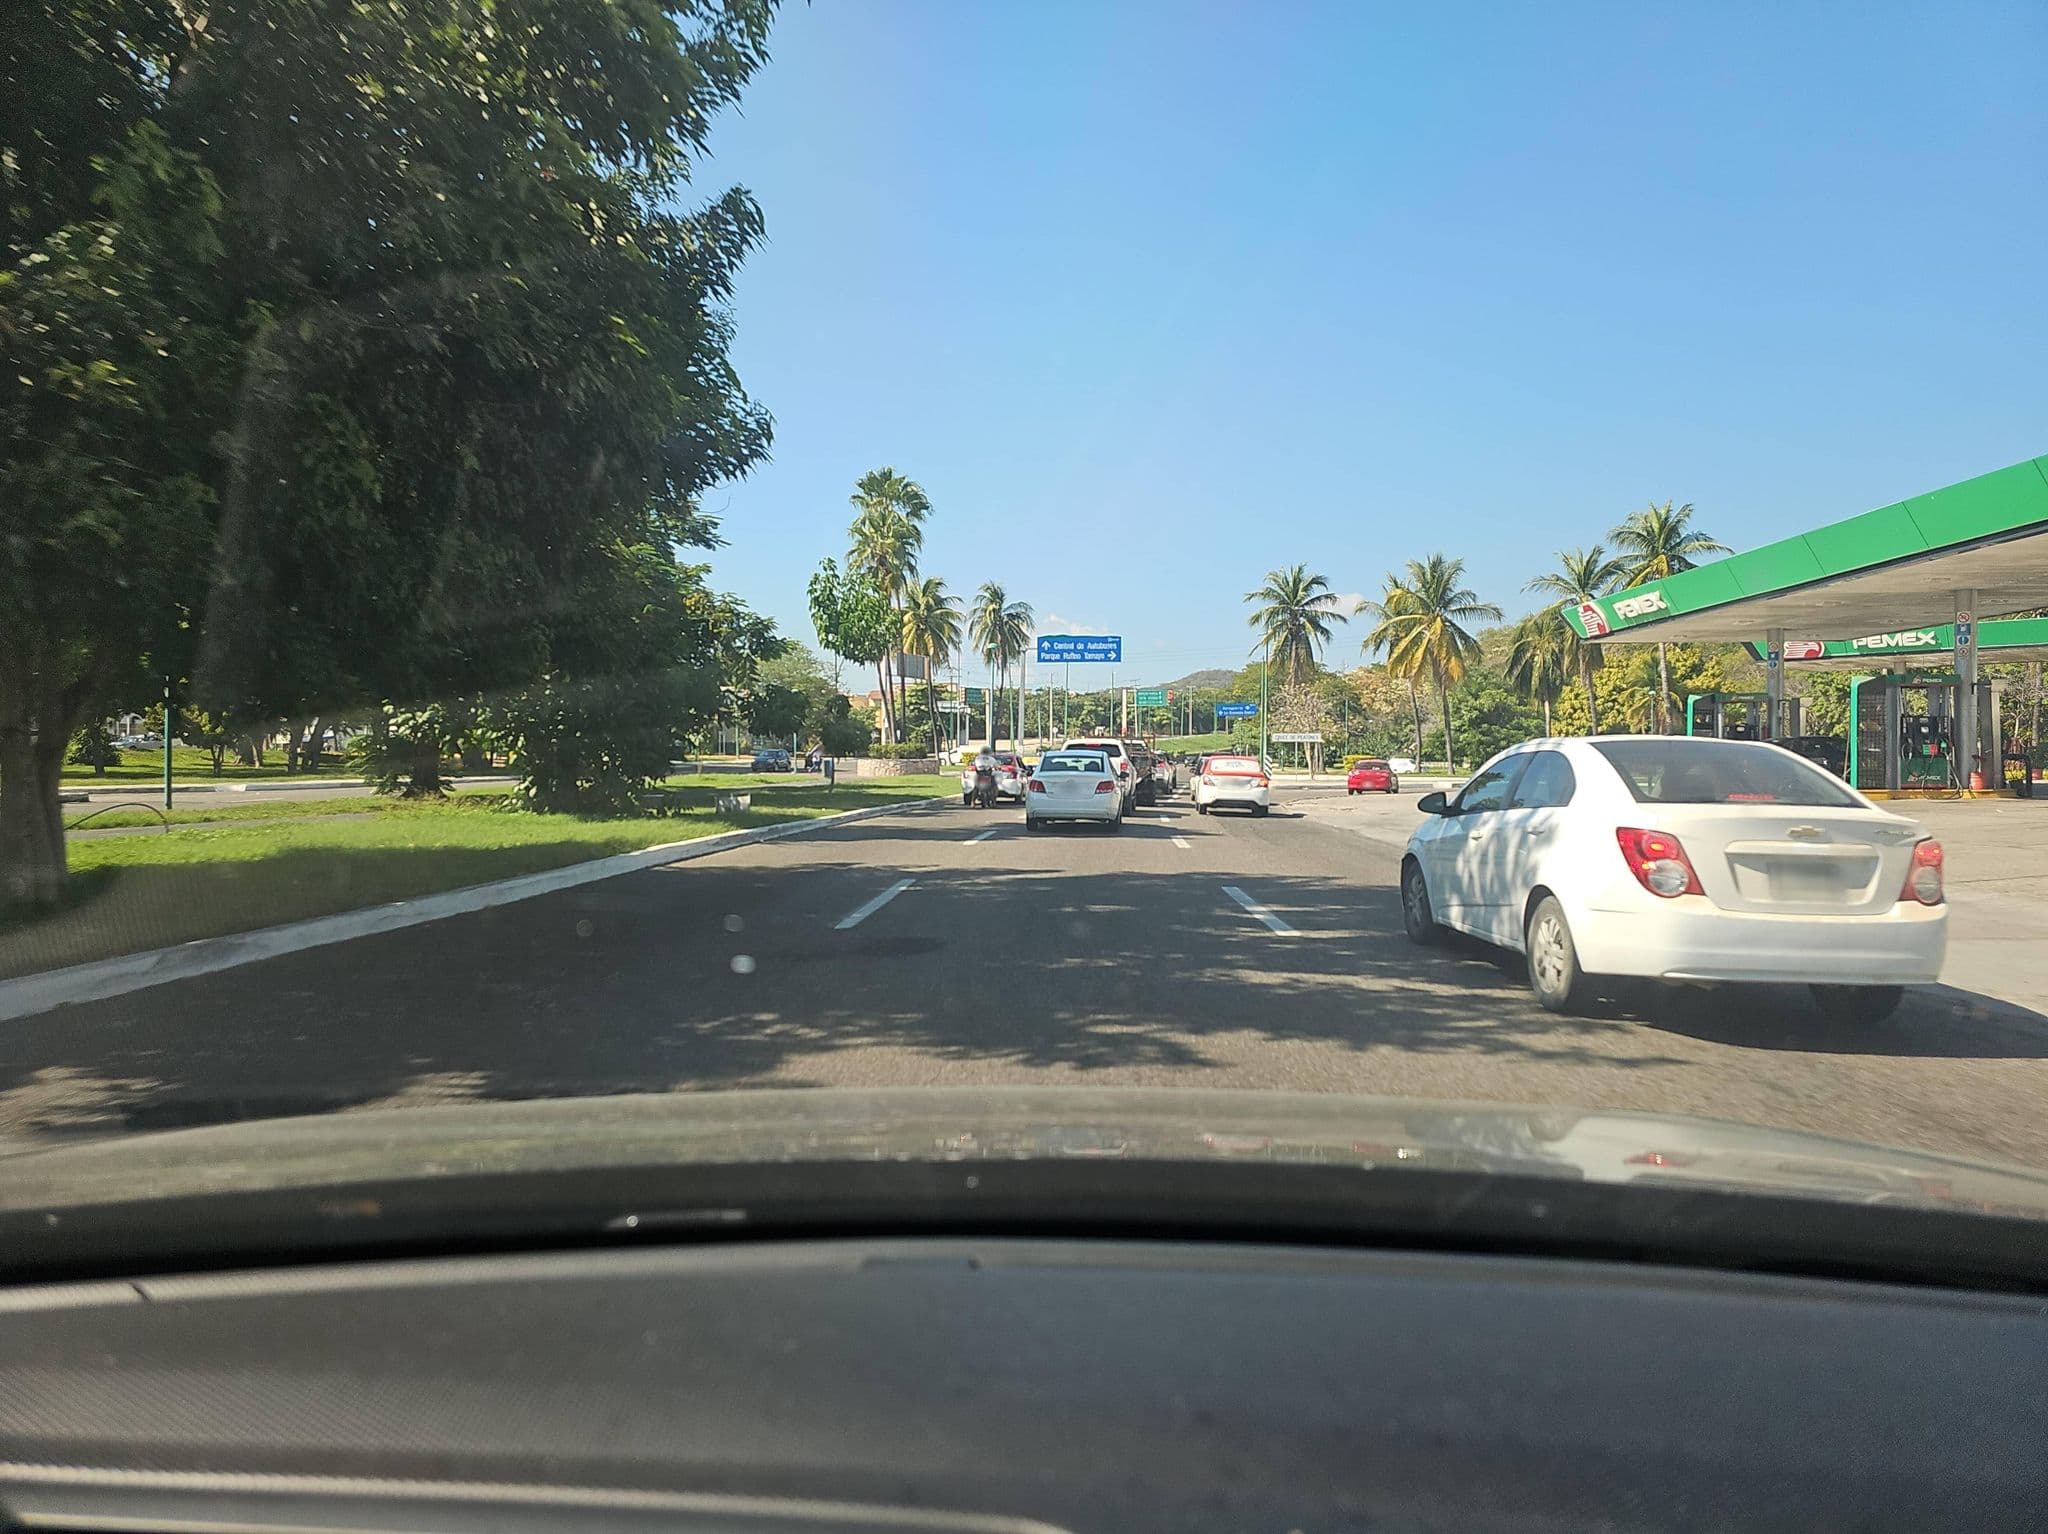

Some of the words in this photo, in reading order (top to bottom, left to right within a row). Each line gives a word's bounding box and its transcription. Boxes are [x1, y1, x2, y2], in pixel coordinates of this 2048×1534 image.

[1852, 631, 1936, 649] PEMEX
[1053, 642, 1074, 650] Central
[1076, 642, 1084, 650] de
[1040, 652, 1061, 660] Parque
